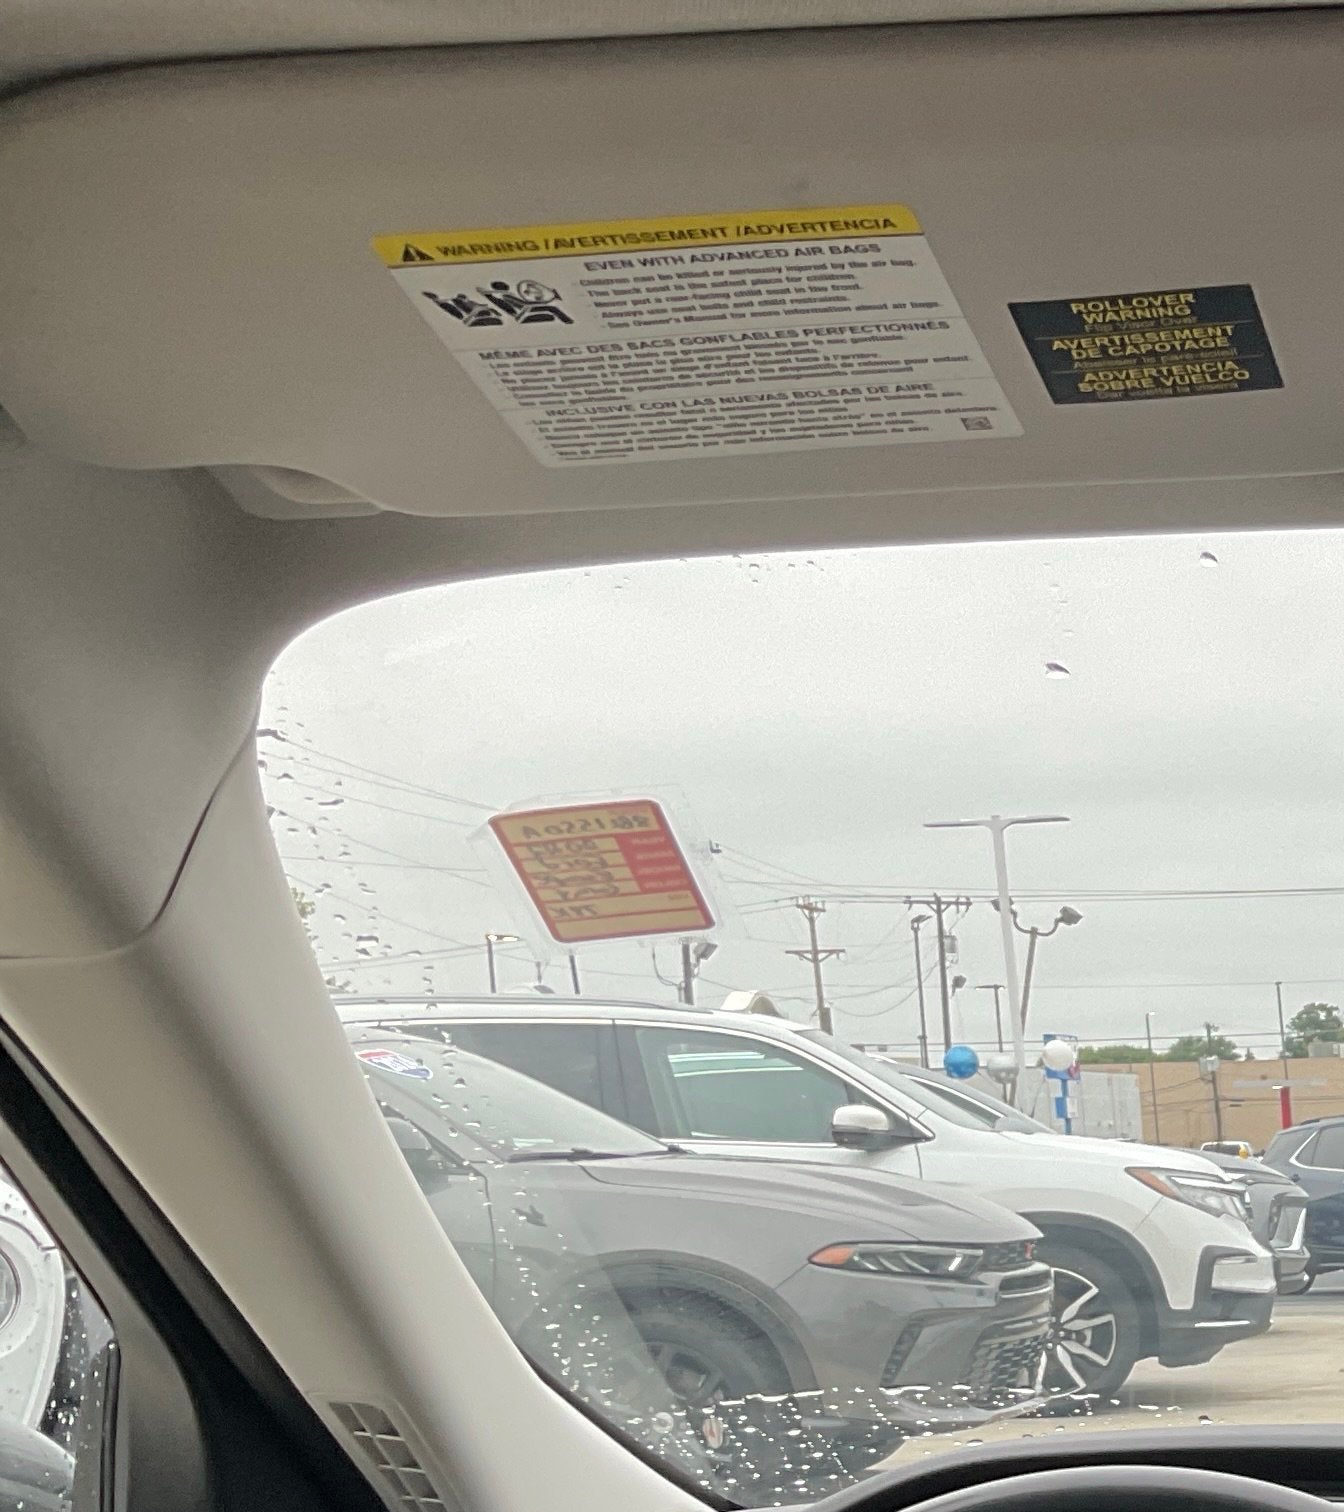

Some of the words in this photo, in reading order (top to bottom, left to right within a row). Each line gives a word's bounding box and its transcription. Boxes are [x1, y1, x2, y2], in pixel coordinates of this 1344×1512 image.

[436, 239, 540, 258] WARNING
[584, 257, 633, 272] EVEN
[638, 254, 686, 269] WITH
[690, 247, 789, 264] ADVANCED
[794, 244, 824, 258] AIR
[829, 242, 882, 255] BAGS
[1070, 293, 1195, 314] ROLLOVER
[1082, 305, 1191, 324] WARNING
[537, 346, 583, 358] AVEC
[586, 343, 624, 355] DES
[627, 338, 676, 352] SACS
[680, 328, 799, 346] GONFLABLES
[1051, 326, 1234, 350] AVERTISSEMENT
[1070, 348, 1102, 361] DE
[1107, 337, 1231, 357] CAPOTAGE
[1077, 376, 1157, 393] SOBRE
[1162, 369, 1250, 387] VUELCO
[1083, 360, 1240, 383] ADVERTENCIA
[546, 403, 637, 418] INCLUSIVE
[640, 399, 678, 412] CON
[681, 396, 716, 409] LAS
[718, 391, 789, 406] NUEVAS
[792, 386, 864, 401] BOLSAS
[867, 384, 890, 395] DE
[895, 382, 936, 394] AIRE
